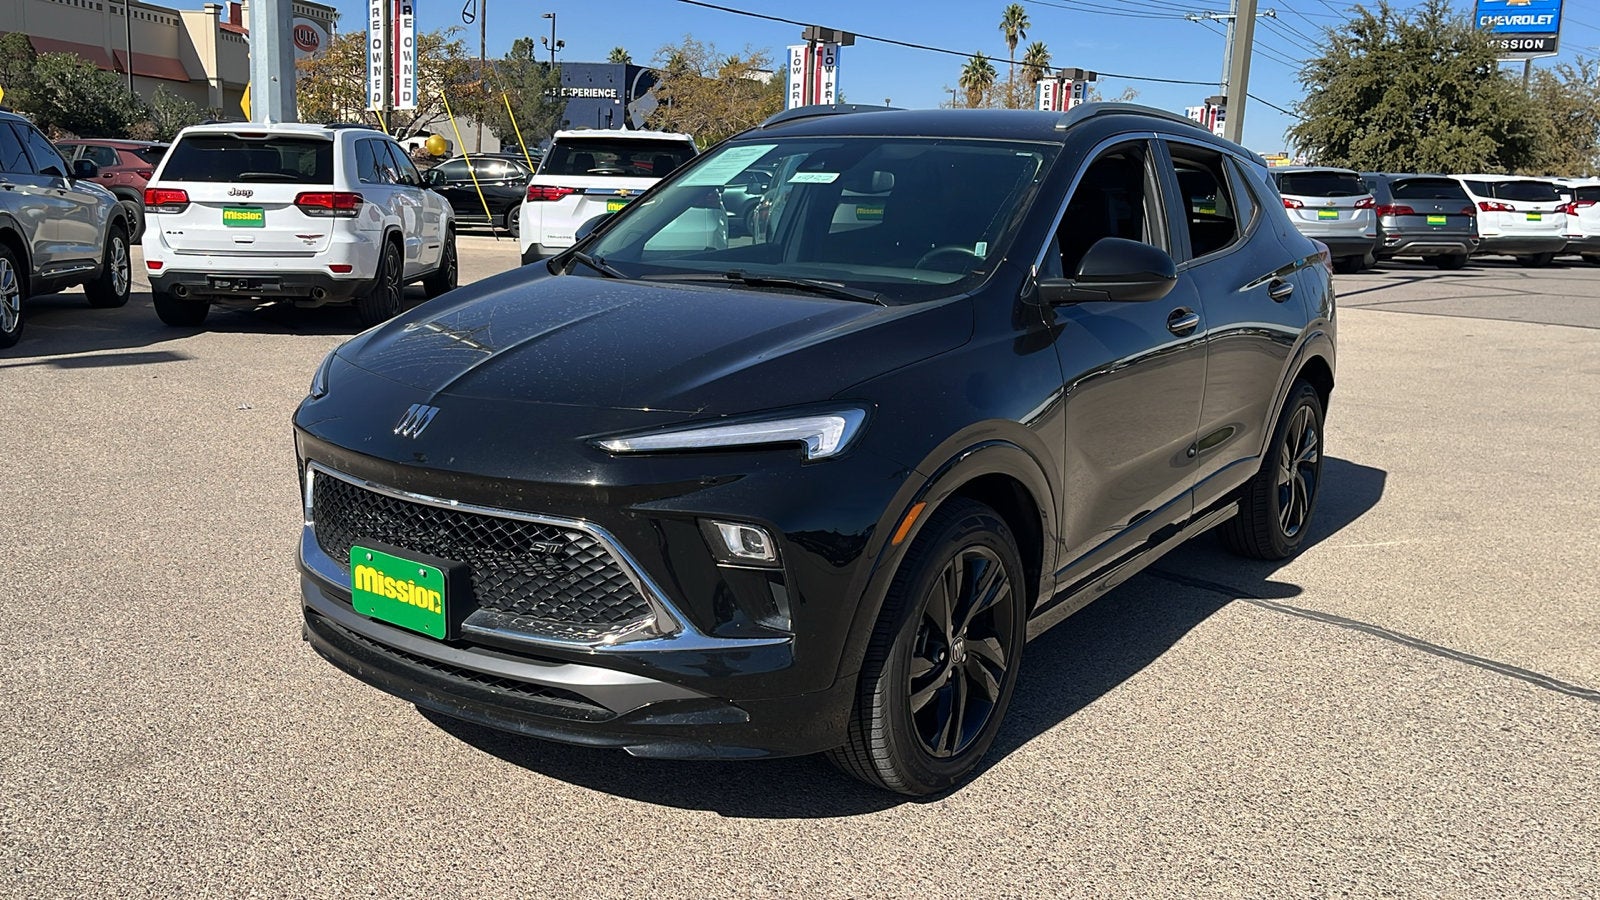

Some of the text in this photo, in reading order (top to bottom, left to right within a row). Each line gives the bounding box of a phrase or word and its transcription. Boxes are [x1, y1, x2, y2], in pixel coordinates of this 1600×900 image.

[1480, 15, 1555, 26] CHEVROLET
[298, 28, 318, 44] ULTA
[372, 39, 381, 102] OWNED
[403, 37, 412, 101] OWNED
[793, 50, 802, 74] LOW
[825, 48, 834, 73] LOW
[561, 87, 617, 98] EXPERIENCE
[228, 188, 253, 198] Jeep
[224, 211, 262, 220] Mission
[354, 564, 442, 614] Mission
